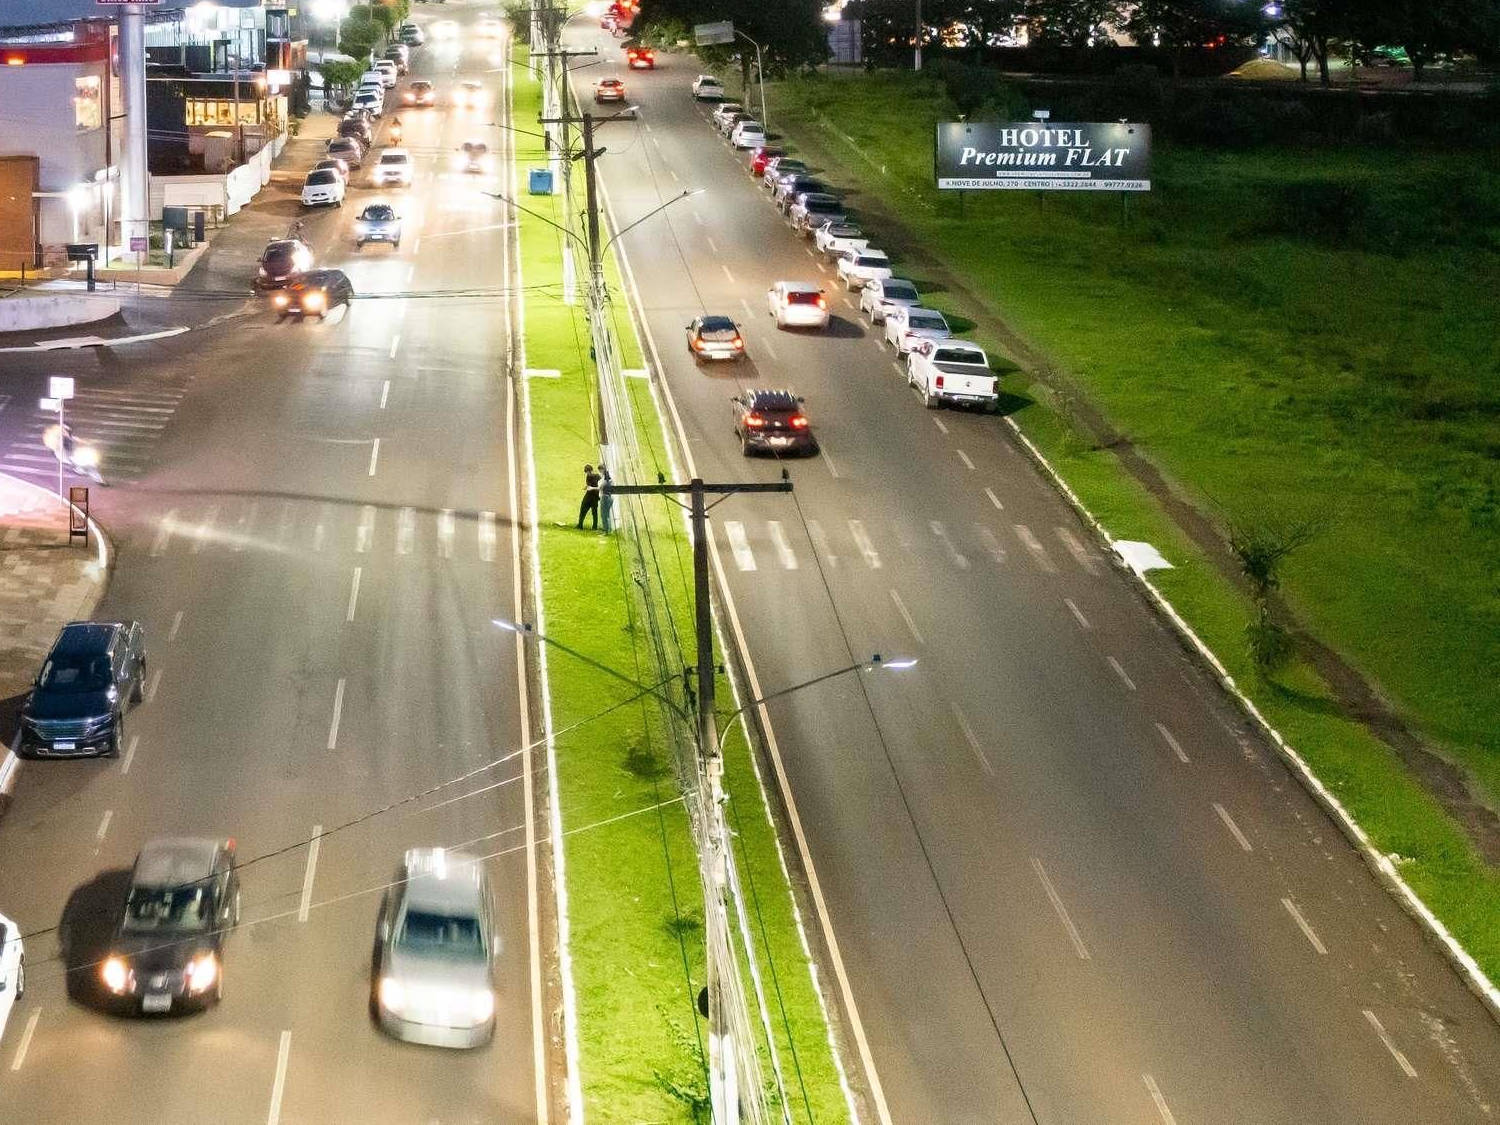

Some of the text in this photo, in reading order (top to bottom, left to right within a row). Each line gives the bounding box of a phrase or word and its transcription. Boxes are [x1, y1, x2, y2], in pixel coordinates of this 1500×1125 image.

[1000, 128, 1089, 148] HOTEL
[959, 147, 1130, 167] Premium FLAT
